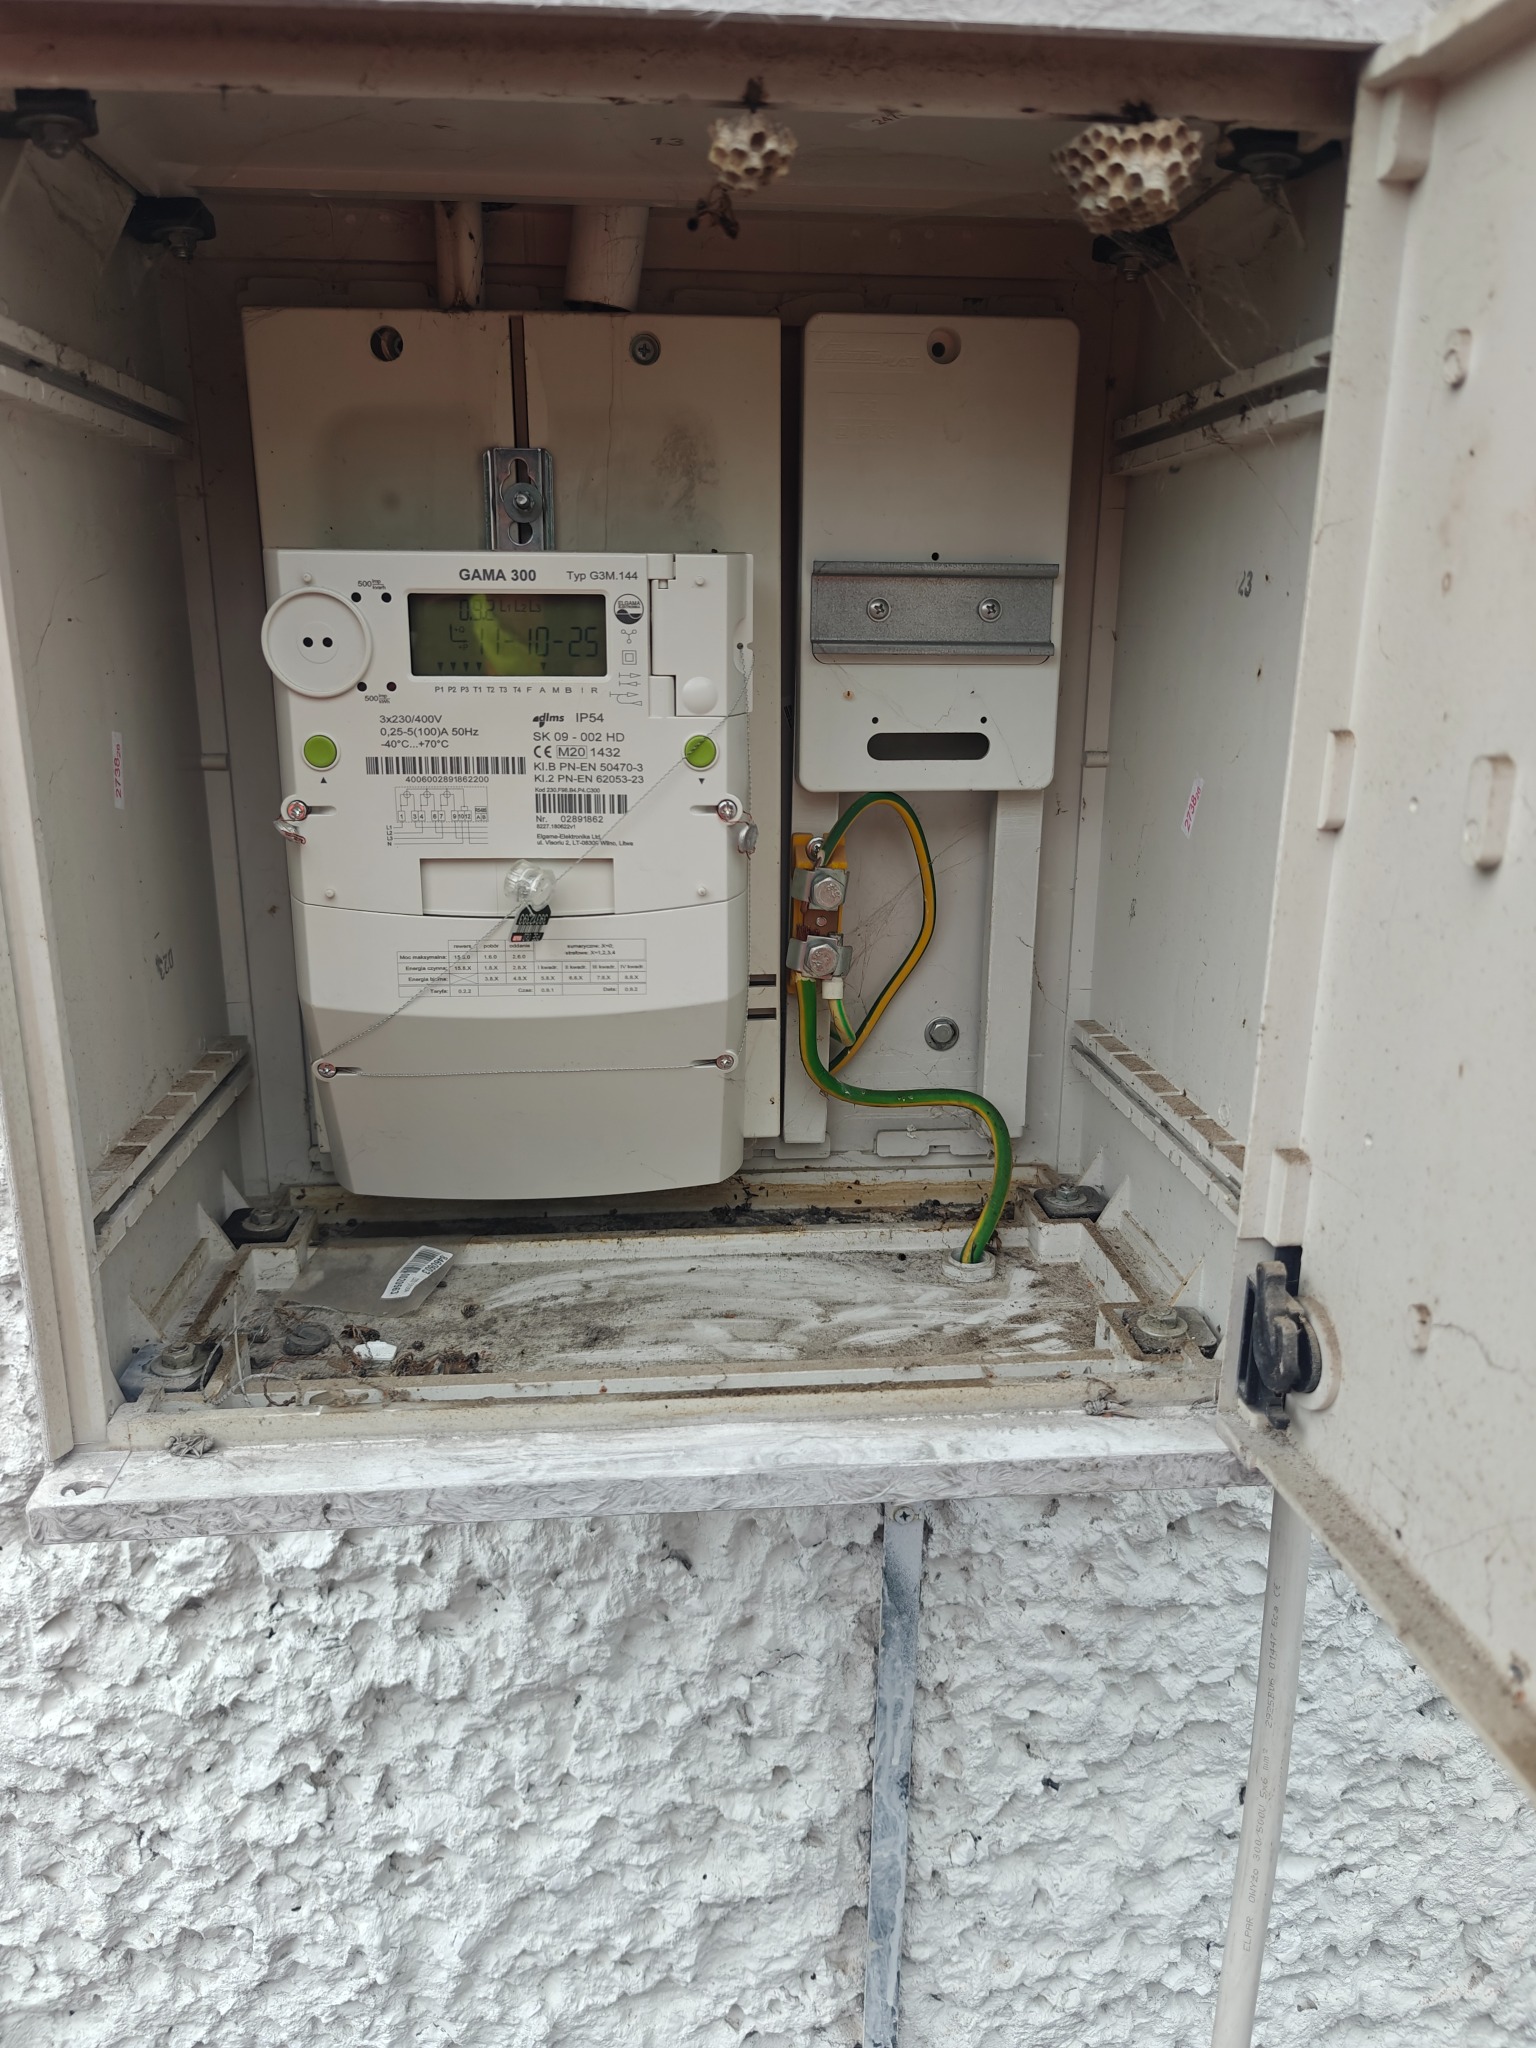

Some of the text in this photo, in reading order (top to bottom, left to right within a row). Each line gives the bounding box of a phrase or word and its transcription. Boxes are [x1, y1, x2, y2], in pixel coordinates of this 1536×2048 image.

[458, 568, 536, 582] GAMA 300
[566, 570, 638, 582] Typ G3M.144
[358, 580, 372, 588] 500
[379, 714, 442, 724] 3x230/400V
[576, 712, 604, 723] IP54
[380, 727, 479, 738] 0,25-5(100)A 50Hz
[533, 731, 551, 742] SK
[554, 732, 569, 742] 09
[580, 732, 602, 742] 002
[606, 732, 625, 742] HD
[558, 747, 586, 757] M20
[590, 747, 621, 758] 1432
[560, 762, 597, 772] PN-EN
[599, 763, 644, 772] 50470-3
[558, 774, 593, 783] PN-EN
[596, 775, 644, 784] 62053-23
[1242, 1916, 1254, 1953] ELPAR
